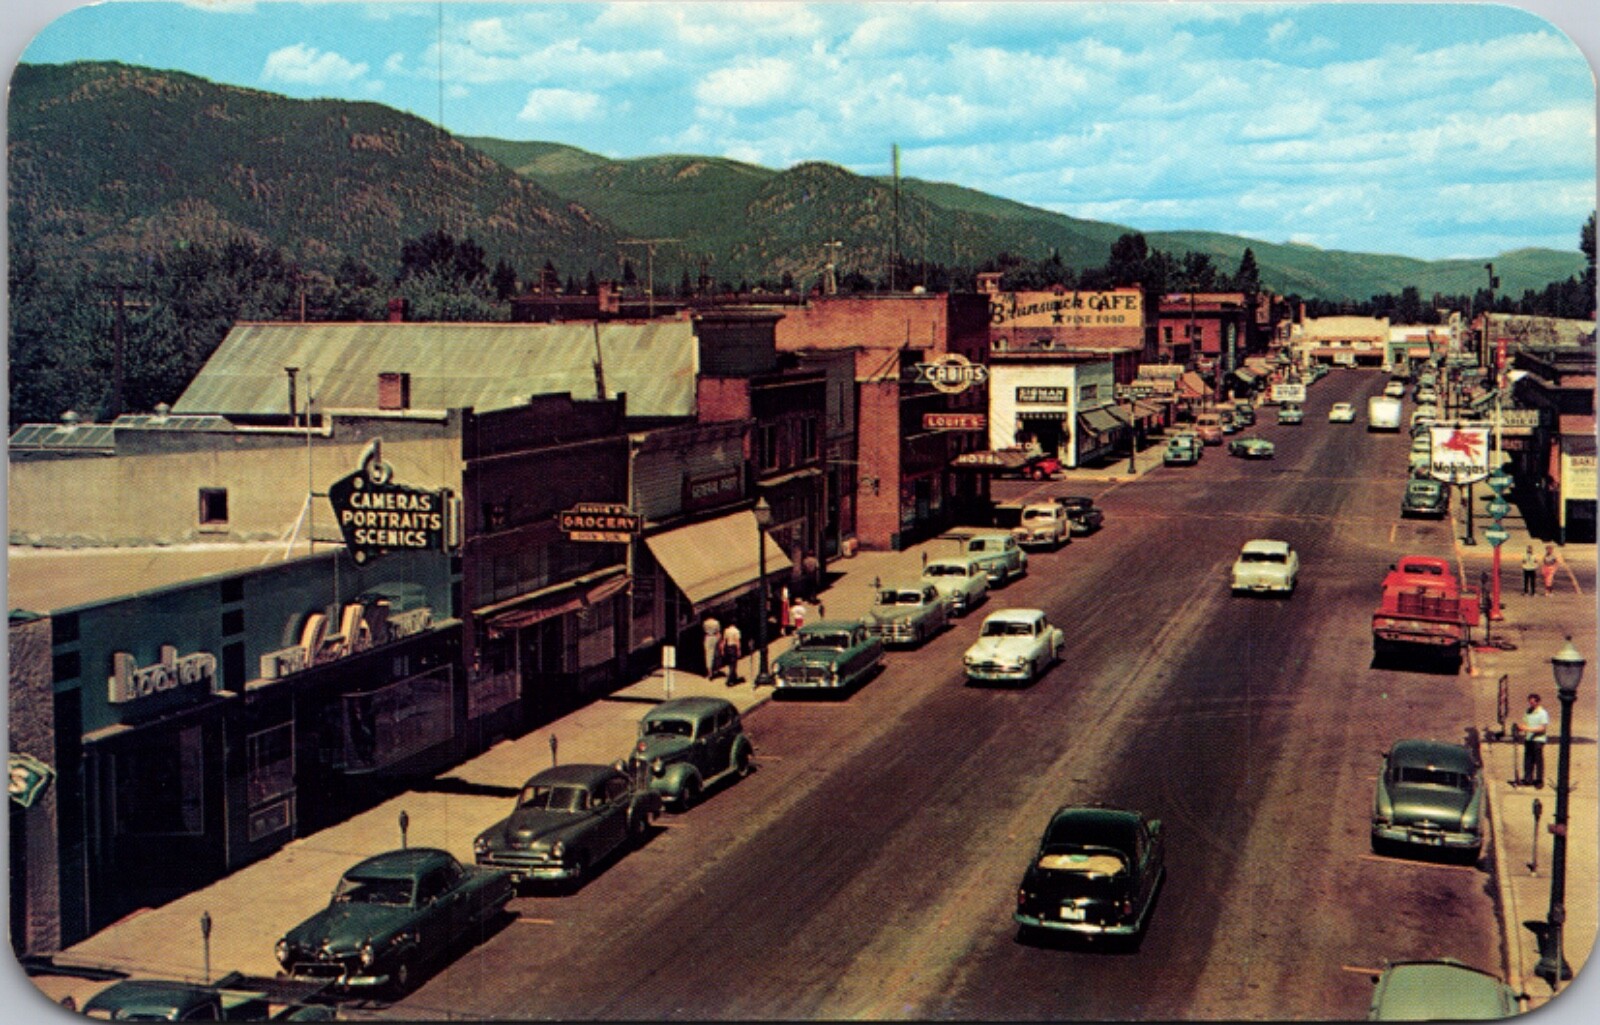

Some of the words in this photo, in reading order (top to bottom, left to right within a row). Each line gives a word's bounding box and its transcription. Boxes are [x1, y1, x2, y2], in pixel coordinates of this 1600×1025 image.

[1088, 294, 1137, 310] CAFE
[1067, 315, 1090, 324] FINE
[1096, 315, 1125, 324] FOOD
[925, 366, 984, 381] CABINS
[927, 417, 978, 427] LOUIE'S
[958, 453, 1004, 465] HOTEL
[1433, 461, 1485, 477] Mobilgas
[350, 492, 431, 511] CAMERAS
[342, 510, 441, 530] PORTRAITS
[563, 516, 636, 528] GROCERY
[354, 529, 427, 547] SCENICS
